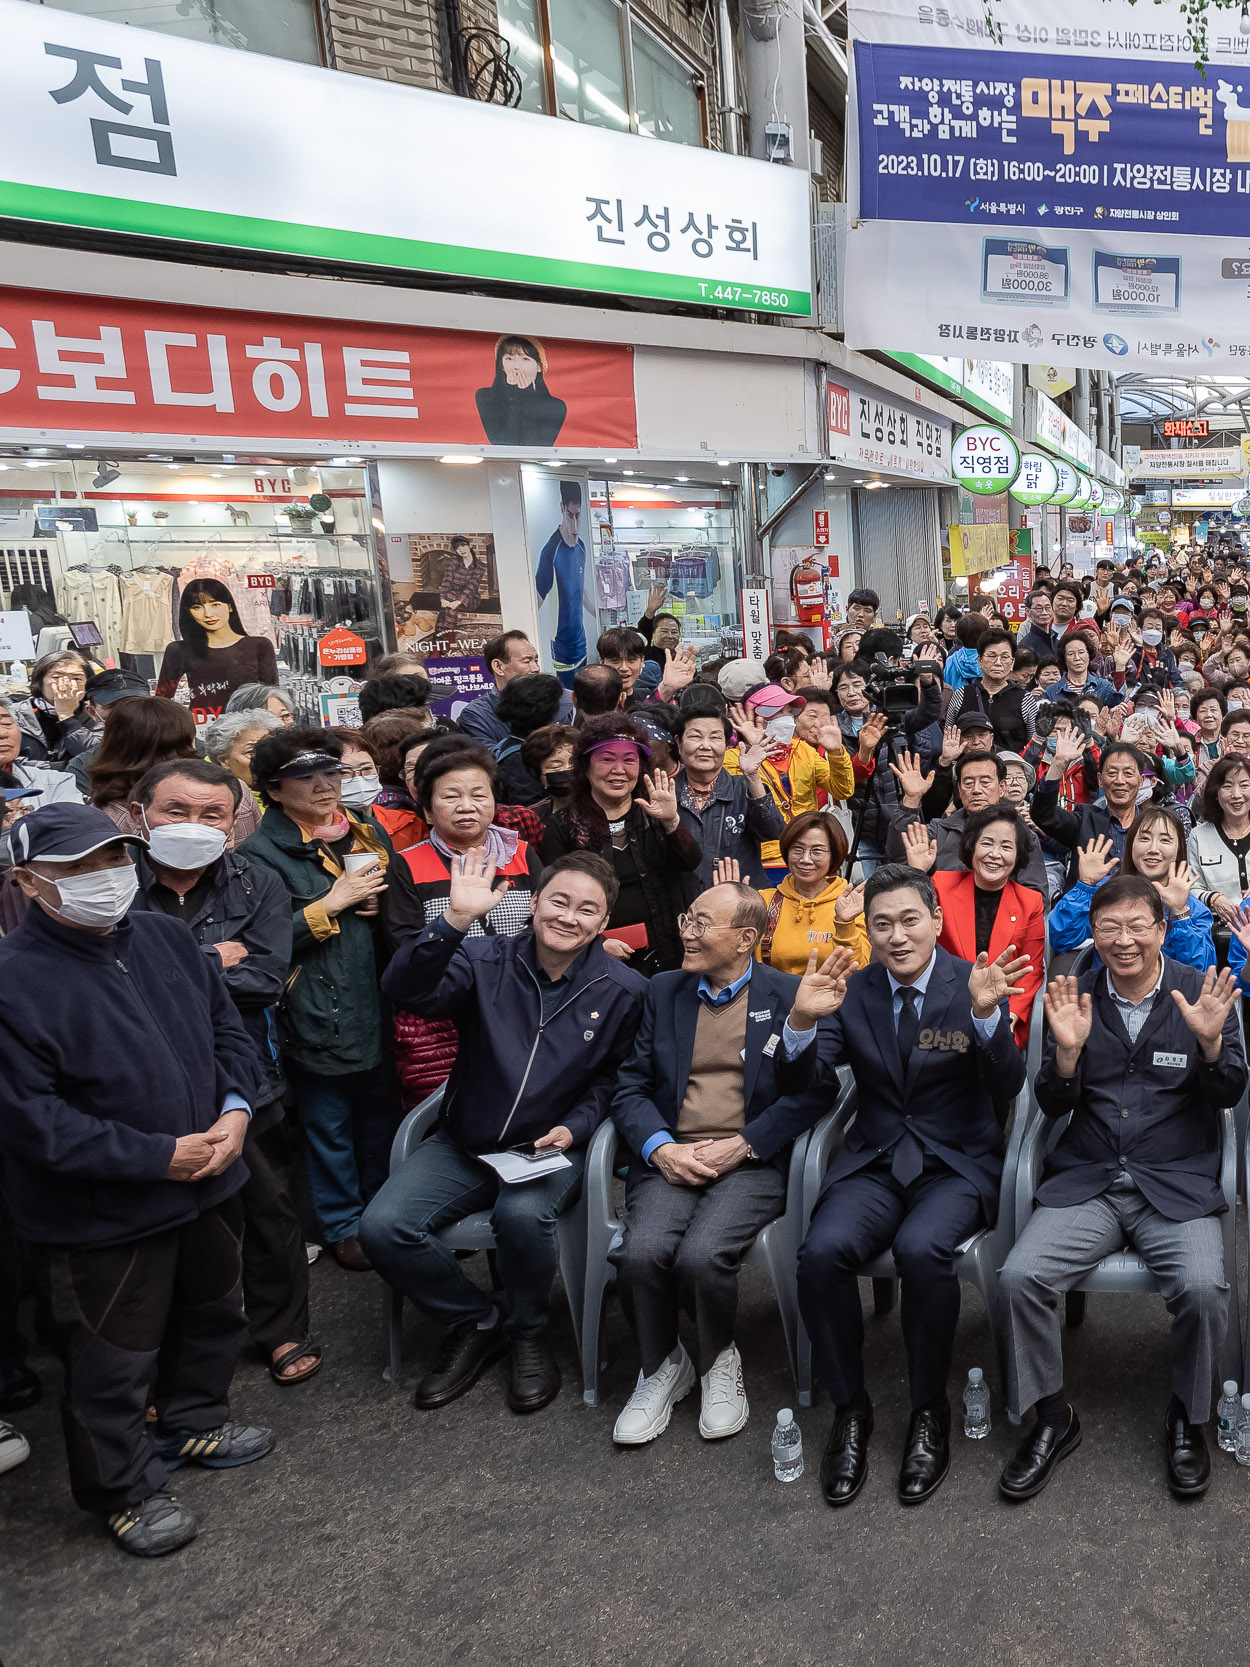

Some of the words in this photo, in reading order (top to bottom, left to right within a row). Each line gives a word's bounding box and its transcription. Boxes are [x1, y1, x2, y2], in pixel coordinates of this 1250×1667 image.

[43, 41, 178, 177] 점
[1020, 77, 1112, 155] 맥주
[1116, 82, 1213, 135] 페스티벌
[872, 103, 930, 138] 고객과
[878, 154, 965, 178] 2023.10.17
[969, 157, 999, 180] (화)
[1003, 160, 1098, 185] 16:00~20:00
[1112, 162, 1232, 193] 자양전통시장
[979, 201, 1026, 215] 서울특별시
[1053, 205, 1084, 216] 광진구
[1109, 208, 1154, 220] 자양전통시장
[1156, 210, 1179, 221] 상인회
[585, 196, 759, 261] 진성상회
[698, 281, 789, 310] T.447-7850
[830, 391, 848, 430] BYC
[859, 398, 908, 448] 진성상회
[915, 419, 942, 458] 직영점
[966, 437, 1001, 451] BYC
[960, 455, 1009, 474] 직영점
[1023, 461, 1042, 473] 하림
[1149, 460, 1185, 469] 자양전통시장
[254, 478, 292, 494] BYC
[975, 480, 993, 490] 속옷
[1026, 473, 1040, 489] 닭
[250, 577, 272, 586] BYC
[998, 586, 1020, 600] 오리
[749, 595, 761, 625] 타월
[405, 640, 449, 653] NIGHT
[458, 638, 488, 650] WEA
[751, 631, 763, 660] 맞춤
[454, 674, 484, 683] 핑크퐁을
[807, 930, 834, 943] TOP
[919, 1028, 969, 1053] 오신환
